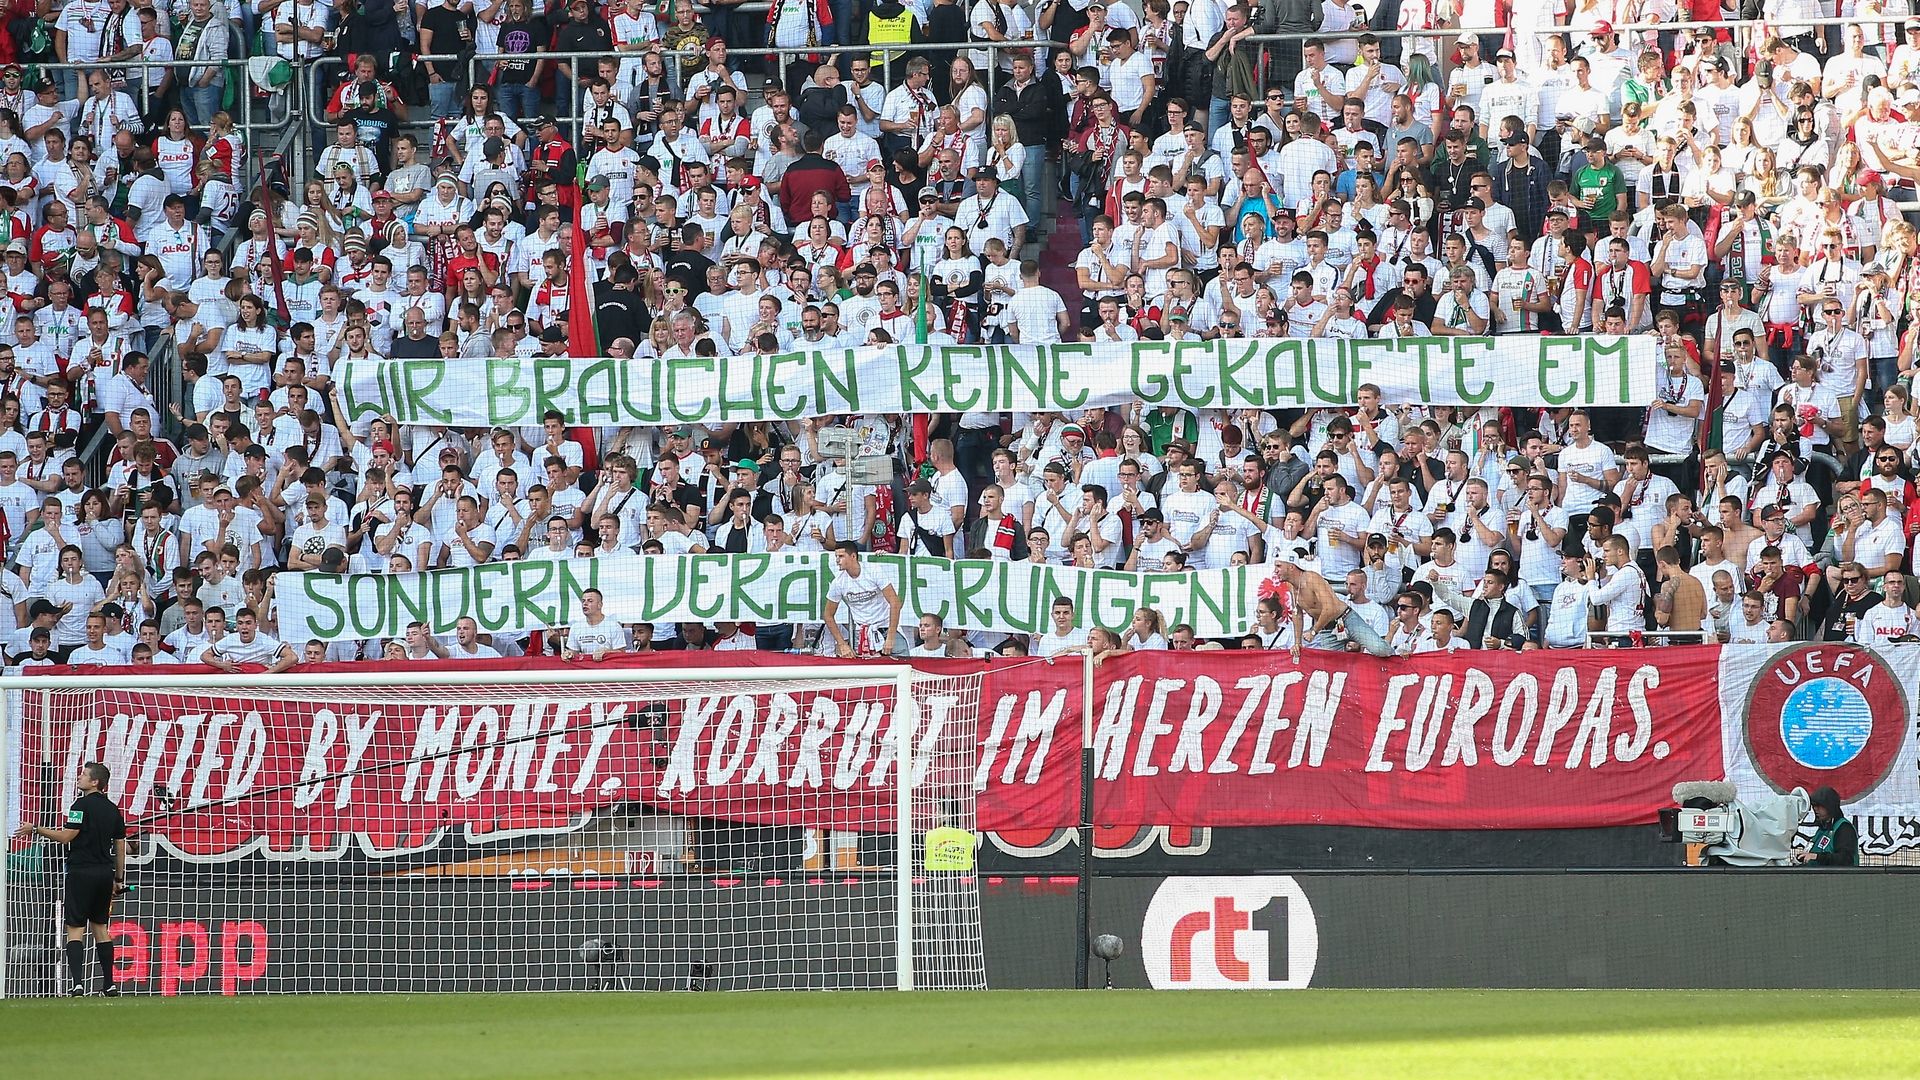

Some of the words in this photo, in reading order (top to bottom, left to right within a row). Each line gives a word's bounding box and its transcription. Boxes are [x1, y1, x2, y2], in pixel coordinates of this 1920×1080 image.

[161, 153, 190, 162] AL-KO
[218, 191, 240, 220] 25
[161, 244, 191, 254] AL-KO
[916, 235, 937, 243] WWK
[344, 360, 452, 425] WIR
[485, 347, 859, 425] BRAUCHEN
[897, 344, 1091, 411] KEINE
[1131, 337, 1494, 409] GEKAUFTE
[1538, 337, 1630, 404] EM
[304, 557, 598, 638] SONDERN
[1876, 627, 1907, 636] AL-KO
[1775, 650, 1874, 688] UEFA
[62, 710, 267, 815] UNITED
[295, 709, 381, 810] BY
[400, 698, 627, 802] MONEY.
[658, 692, 959, 798] KORRUPT
[975, 688, 1067, 793] IM
[1093, 670, 1348, 781] HERZEN
[1365, 664, 1670, 772] EUROPAS.
[1170, 895, 1289, 981] rt1
[108, 920, 269, 996] app
